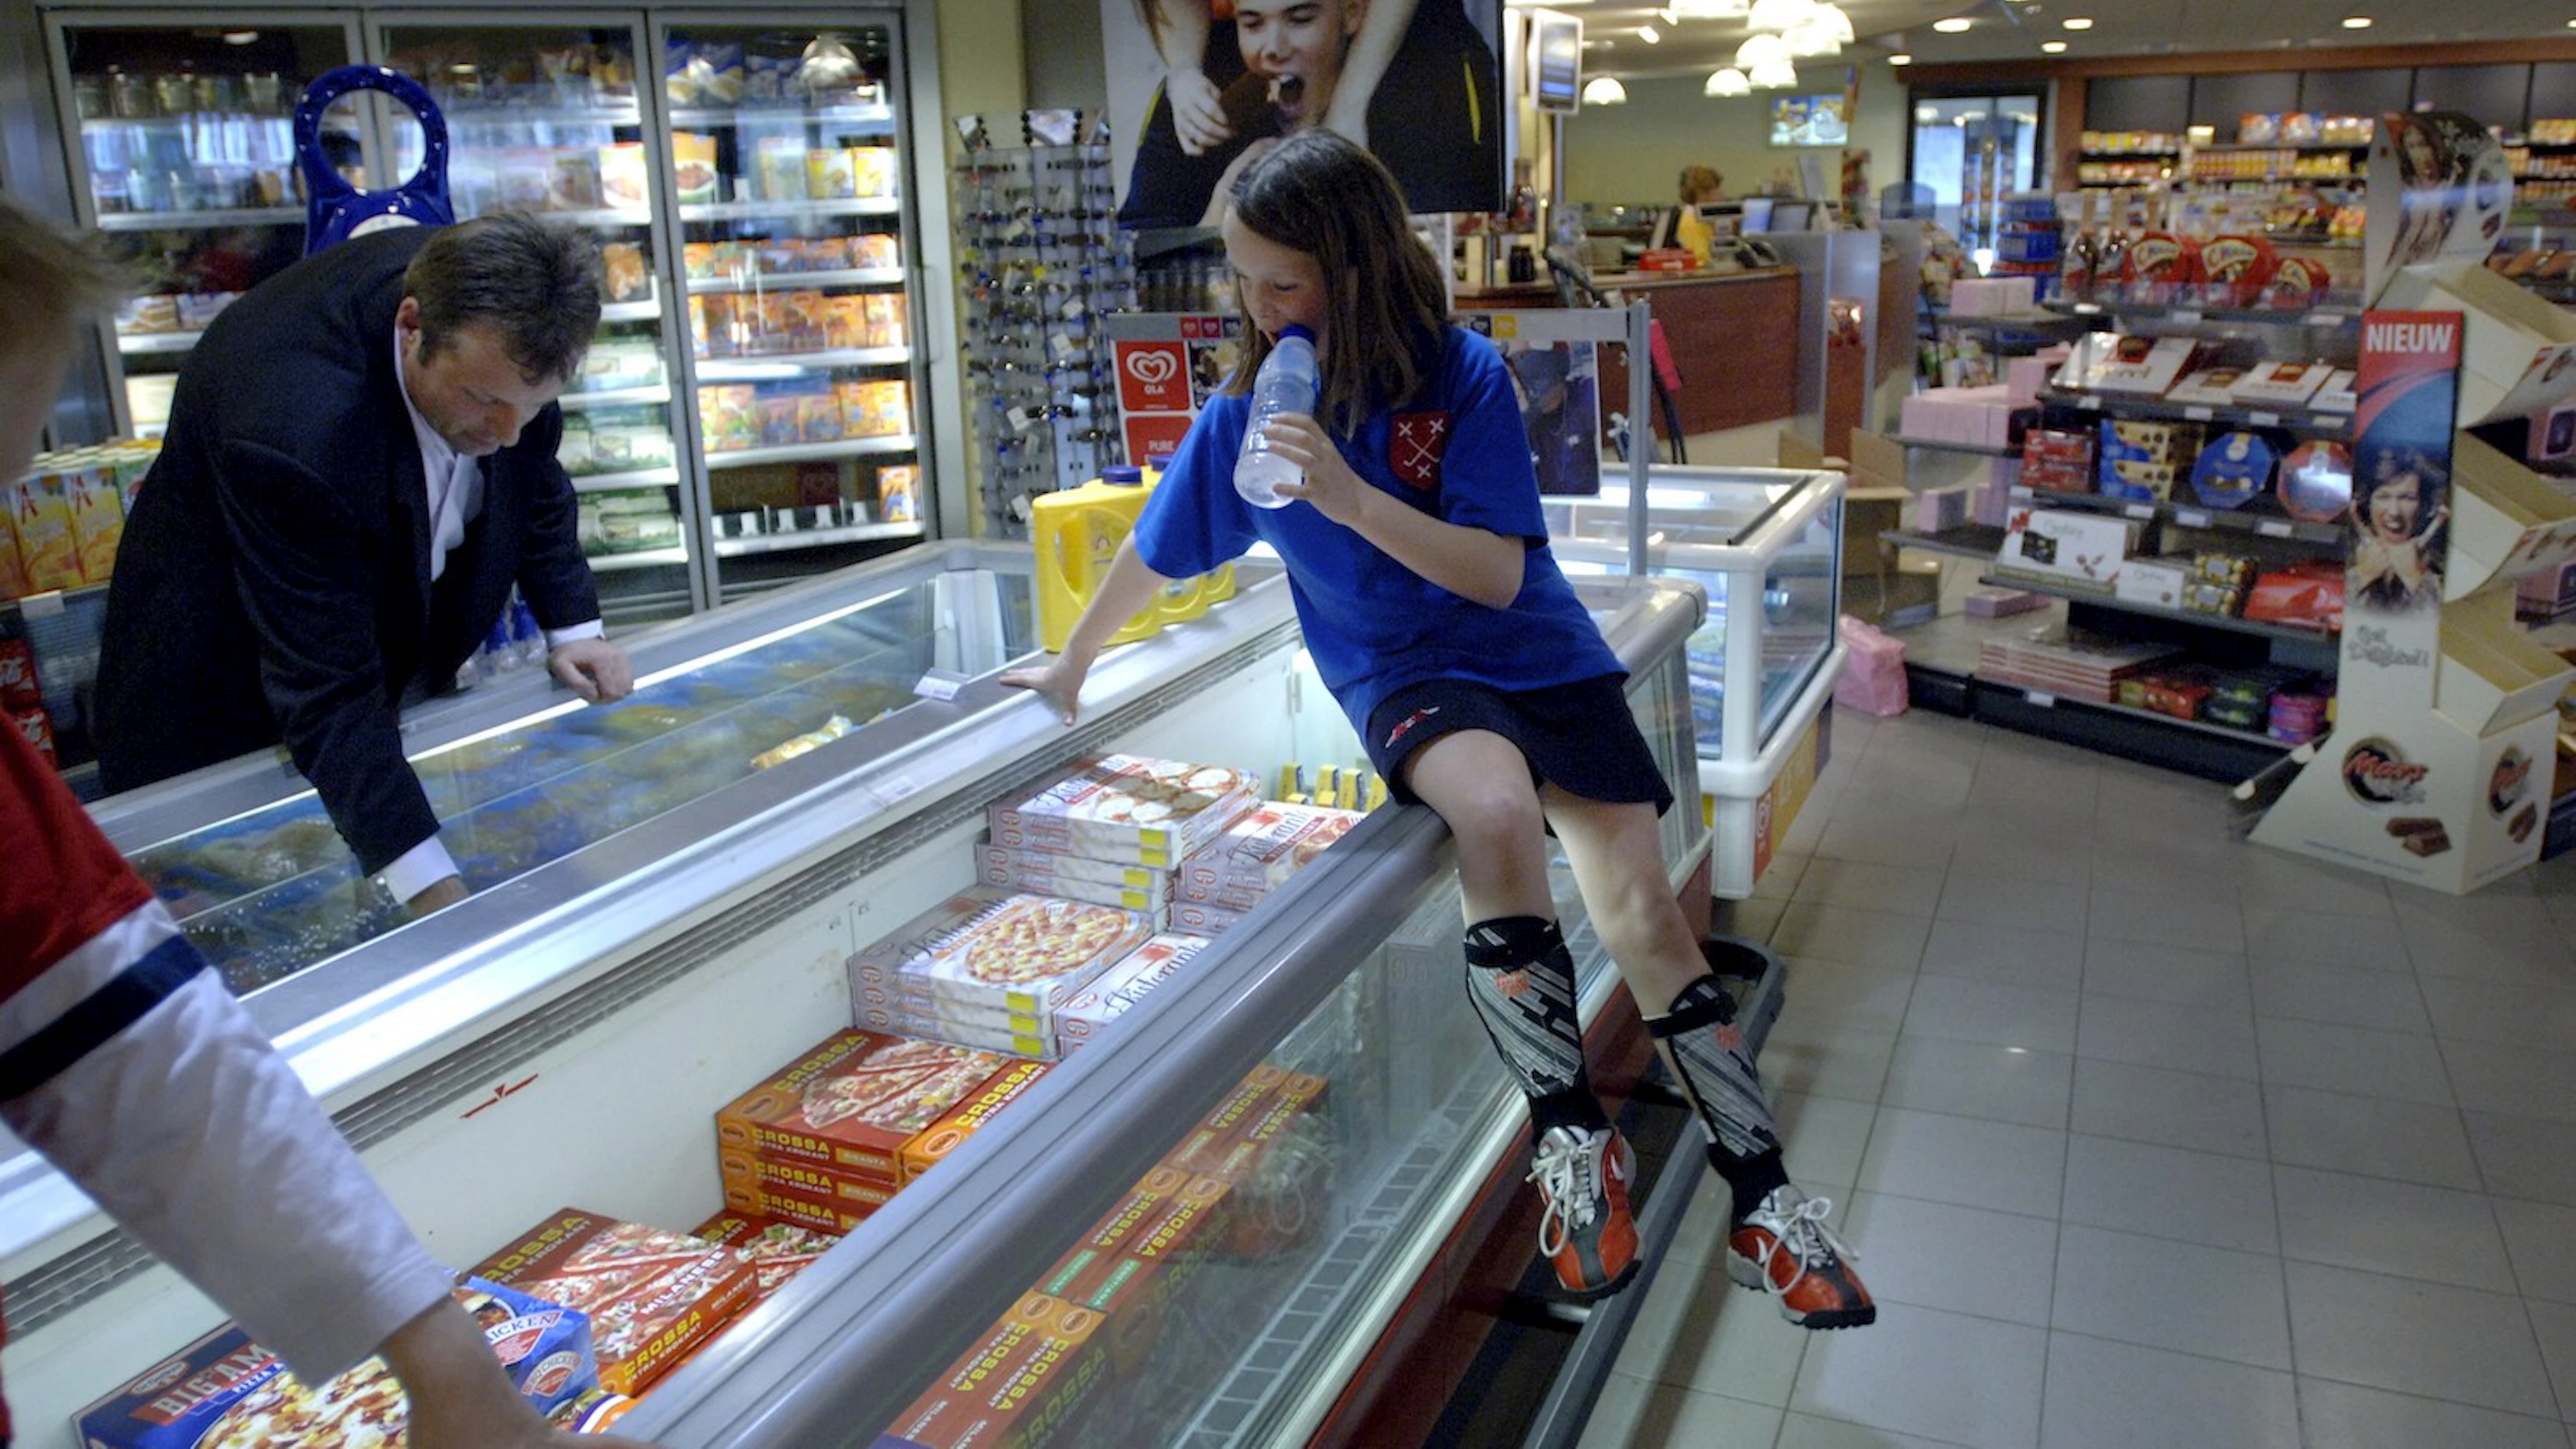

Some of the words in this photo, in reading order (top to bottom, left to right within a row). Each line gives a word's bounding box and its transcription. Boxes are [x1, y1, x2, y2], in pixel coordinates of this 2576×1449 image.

[2366, 323, 2455, 354] NIEUW
[1143, 385, 1165, 395] OLA
[773, 1035, 865, 1091] CROSSA
[955, 1063, 1040, 1126] CROSSA
[1003, 1064, 1046, 1102] KROKANT
[752, 1128, 830, 1153] CROSSA
[787, 1144, 830, 1161] KROKANT
[755, 1161, 833, 1188] CROSSA
[759, 1192, 835, 1220] CROSSA
[1099, 1191, 1160, 1246] CROSSA
[1142, 1201, 1202, 1256] CROSSA
[482, 1217, 586, 1281] ROSSA
[640, 1250, 726, 1315] MILANESE
[491, 1314, 553, 1340] ICKEN
[624, 1310, 702, 1377] CROSSA
[658, 1322, 702, 1360] KROKANT
[957, 1324, 1031, 1392] CROSSA
[996, 1338, 1070, 1410] CROSSA
[151, 1378, 222, 1417] BIG
[232, 1369, 274, 1394] PIZZA
